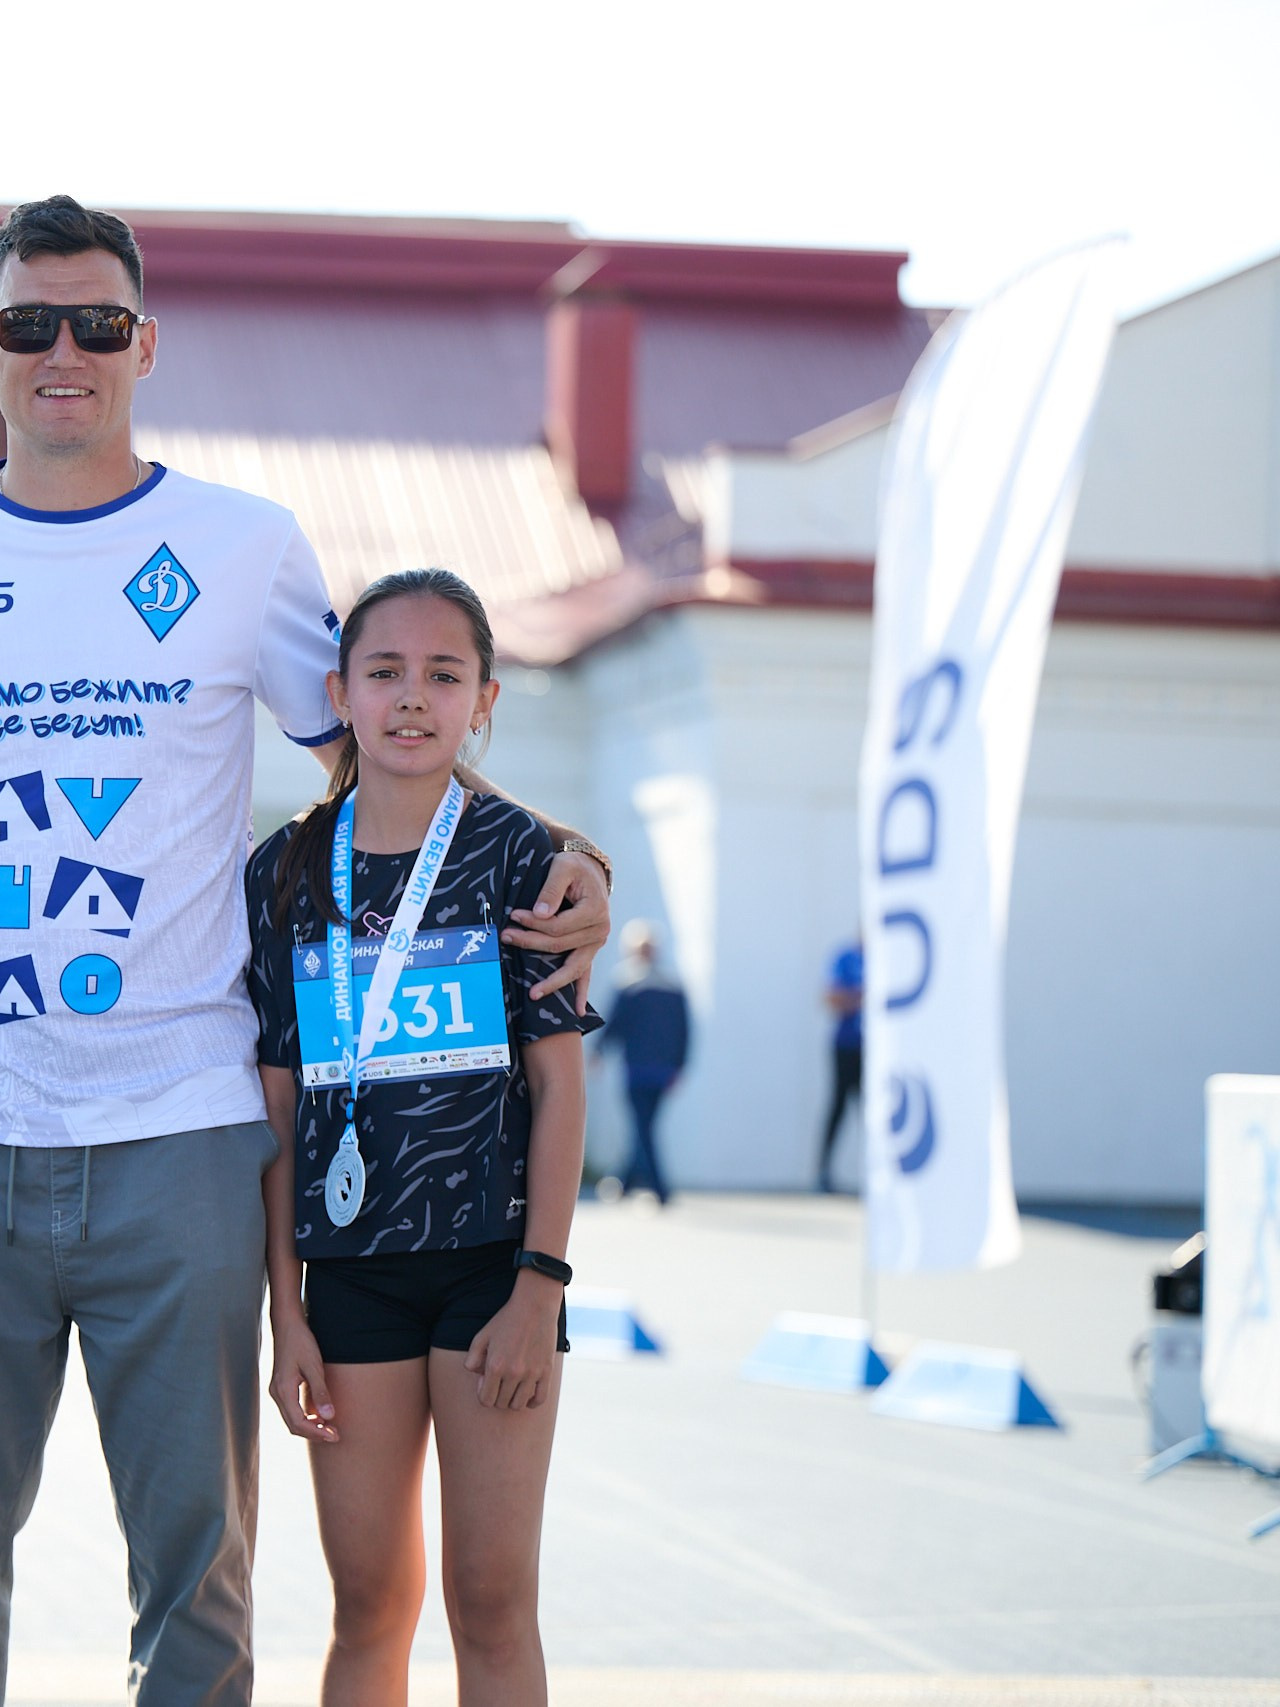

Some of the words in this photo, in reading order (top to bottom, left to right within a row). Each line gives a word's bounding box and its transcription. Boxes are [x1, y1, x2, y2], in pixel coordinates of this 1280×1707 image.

[333, 821, 350, 874] МИЛЯ
[408, 840, 445, 905] БЕЖИТ!
[876, 657, 964, 1013] UDS
[332, 876, 353, 1021] ДИНАМОВКАЯ
